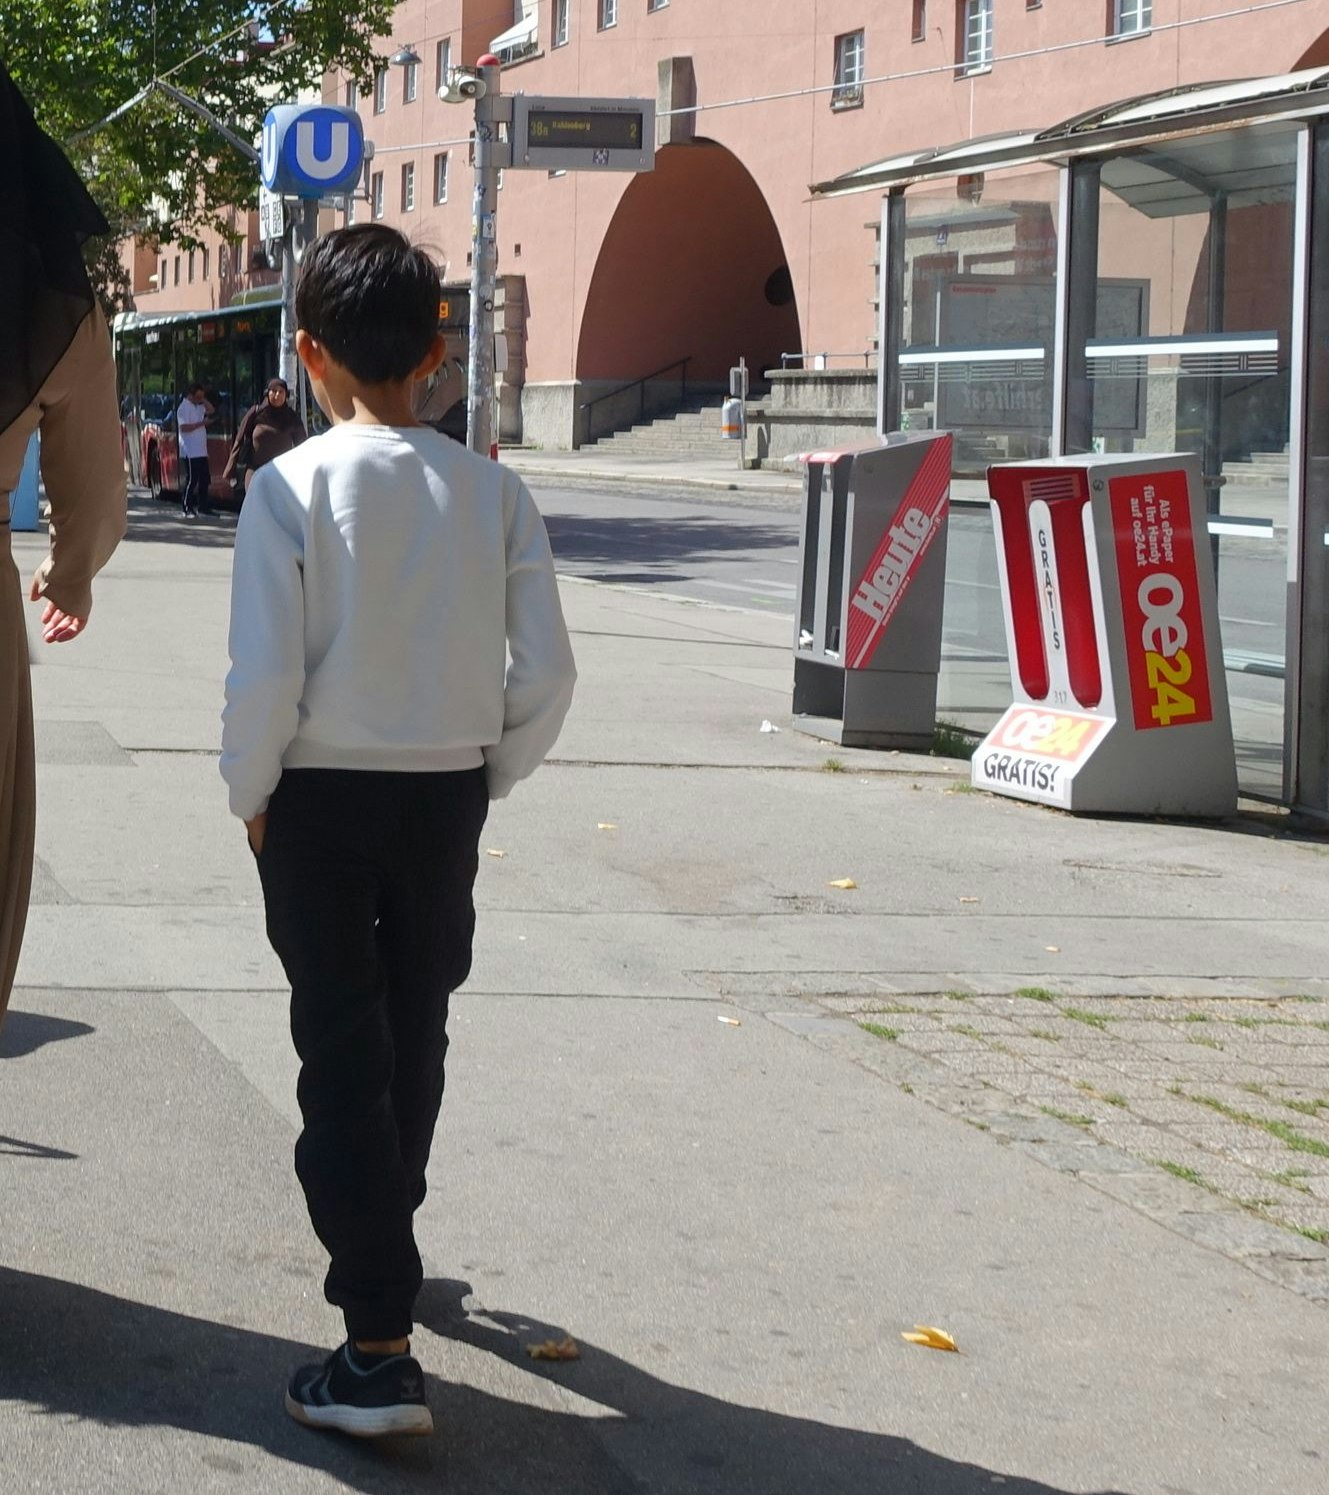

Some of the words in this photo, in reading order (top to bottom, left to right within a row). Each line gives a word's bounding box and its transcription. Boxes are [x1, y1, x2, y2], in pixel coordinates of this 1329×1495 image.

[296, 121, 349, 180] U
[630, 122, 637, 139] 2
[1130, 497, 1143, 518] auf
[1143, 485, 1155, 504] für
[1146, 506, 1157, 523] Ihr
[1159, 499, 1170, 519] Als
[1132, 520, 1148, 568] oe24.at
[1148, 525, 1162, 565] Handy
[1161, 520, 1174, 563] ePaper
[852, 508, 931, 622] Heute
[1037, 529, 1061, 650] GRATIS
[1138, 572, 1196, 725] oe24
[1002, 711, 1092, 756] oe24
[984, 753, 1060, 792] GRATIS!
